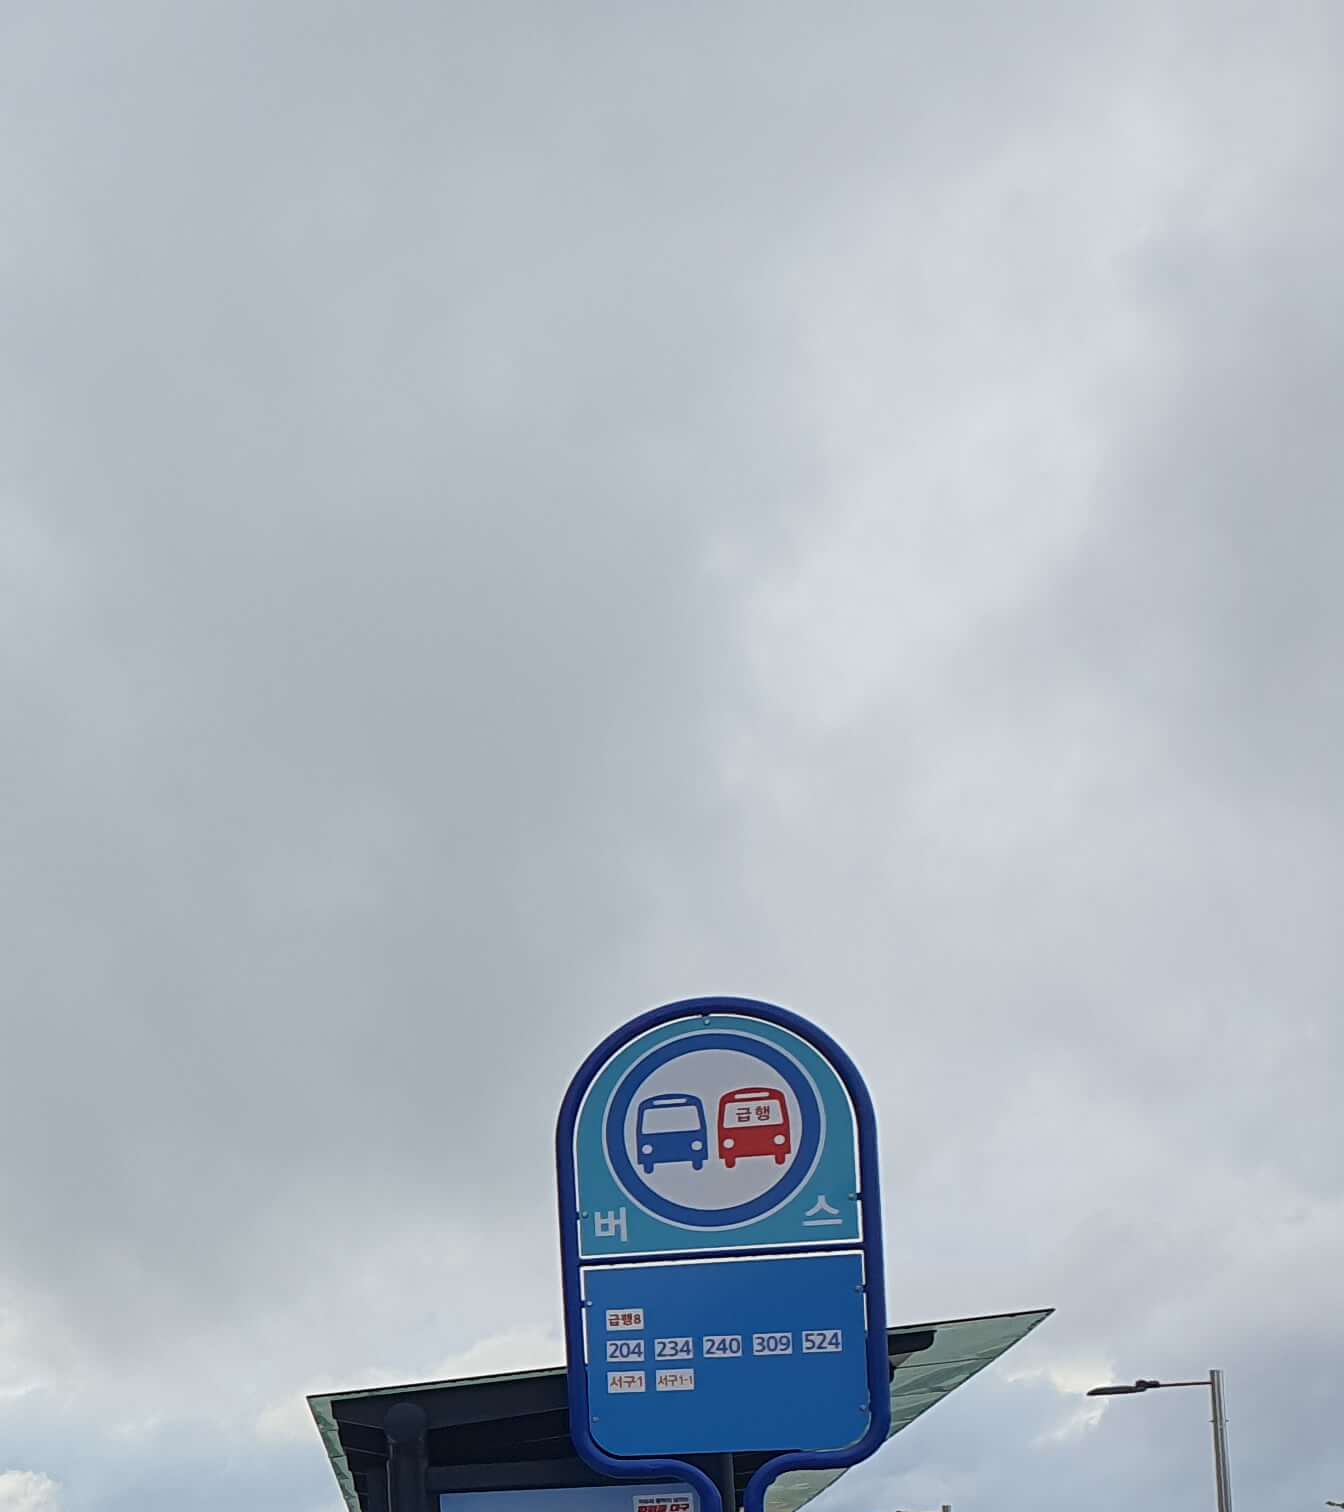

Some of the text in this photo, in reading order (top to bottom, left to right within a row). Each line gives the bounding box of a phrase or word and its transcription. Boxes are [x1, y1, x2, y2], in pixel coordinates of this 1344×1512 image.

[735, 1105, 771, 1123] 급행
[594, 1194, 844, 1242] 버 스
[608, 1312, 642, 1328] 급행8
[609, 1332, 841, 1360] 204 234 240 309 524
[610, 1373, 694, 1389] 서구1 서구1-1
